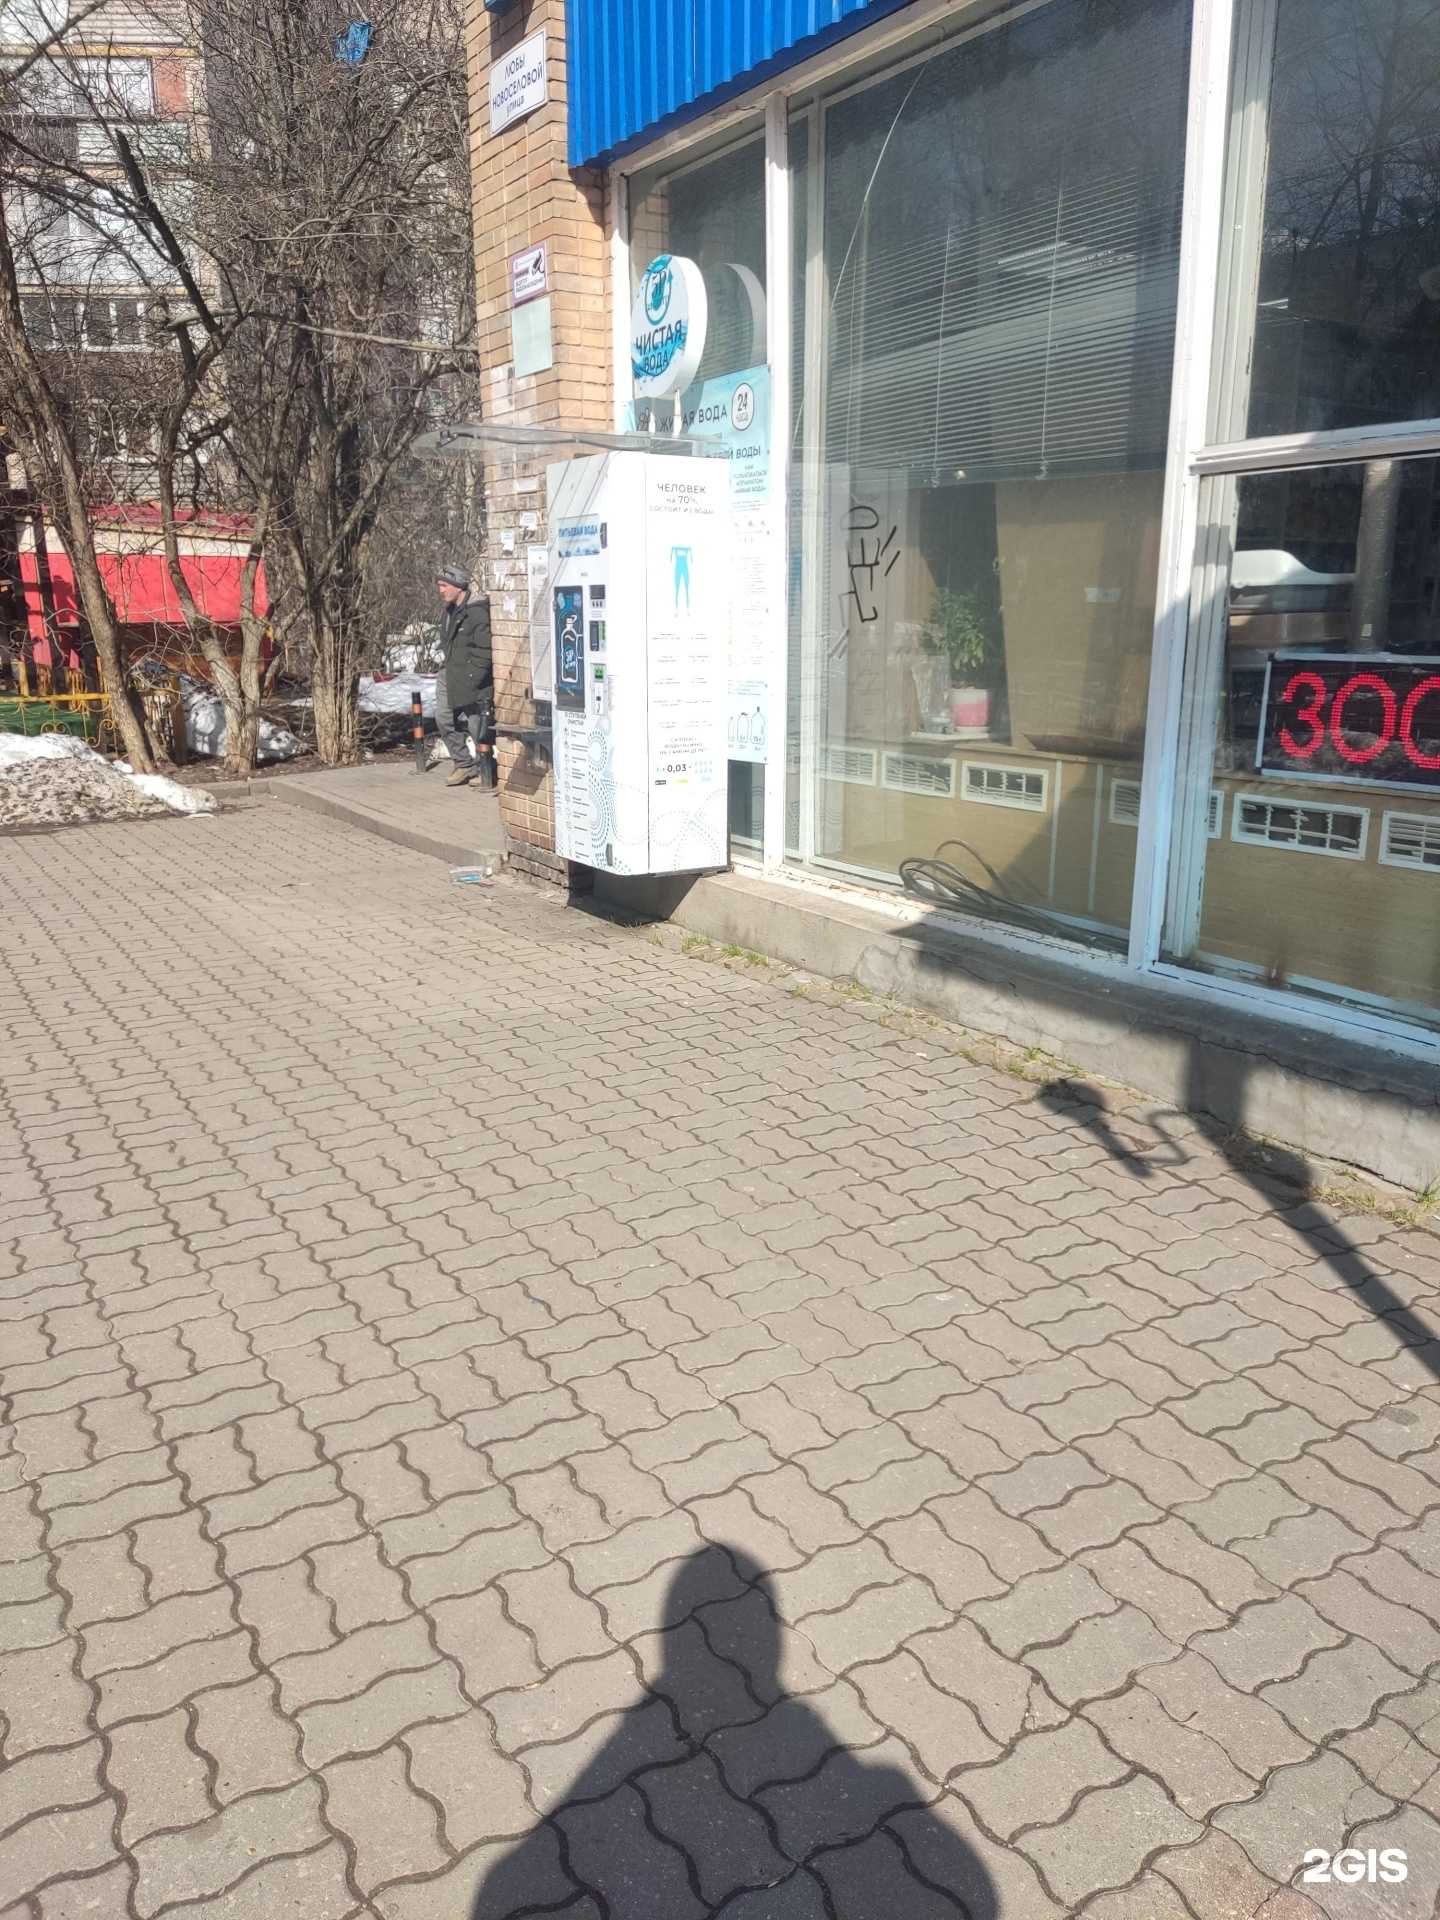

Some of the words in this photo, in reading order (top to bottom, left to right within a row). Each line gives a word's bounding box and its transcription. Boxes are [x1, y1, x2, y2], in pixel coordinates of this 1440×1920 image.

[505, 53, 525, 80] ЛЮБЫ
[492, 62, 543, 111] НОВОСЕЛОВОЙ
[635, 320, 682, 355] ЧИСТАЯ
[644, 351, 670, 373] ВОДА
[737, 391, 748, 412] 24
[660, 411, 695, 433] ЖИАЯ
[698, 404, 728, 424] ВОДА
[736, 445, 761, 460] ВОДЫ
[657, 483, 706, 494] ЧЕЛОВЕК
[666, 763, 687, 774] 0,03
